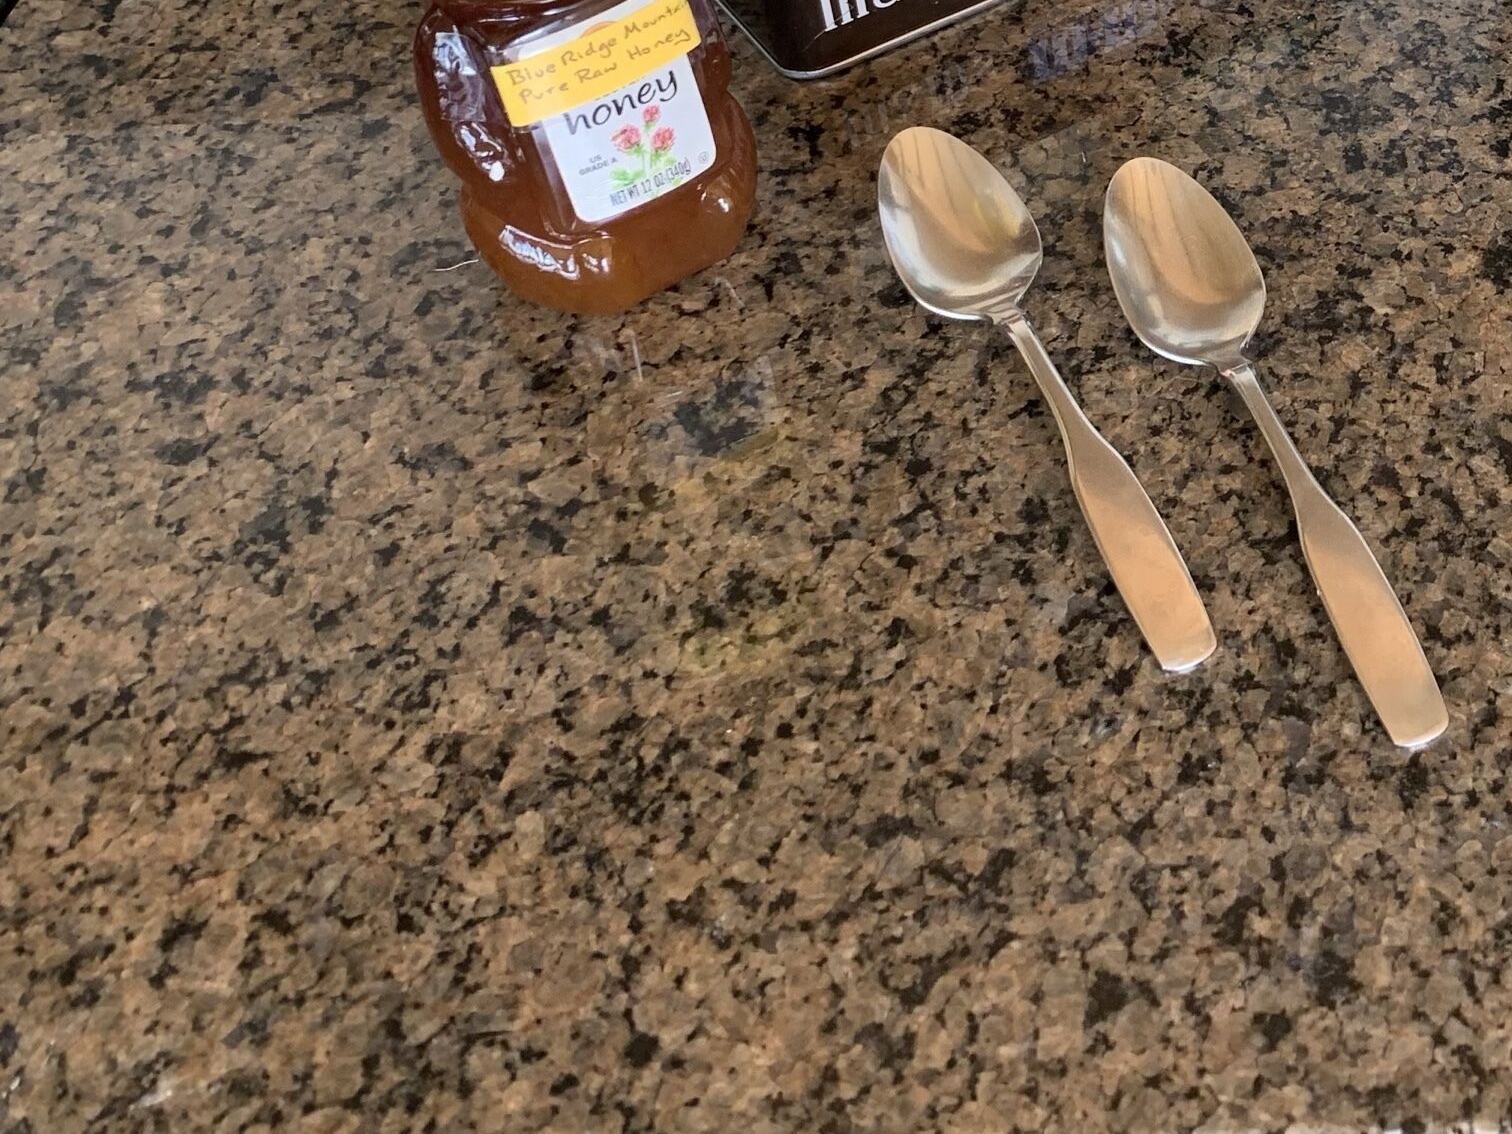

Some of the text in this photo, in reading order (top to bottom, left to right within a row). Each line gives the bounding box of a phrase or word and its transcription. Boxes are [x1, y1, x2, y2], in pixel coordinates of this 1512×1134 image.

[505, 62, 557, 87] Blue
[561, 36, 619, 67] Ridge
[518, 81, 570, 105] Pure
[574, 61, 618, 85] Raw
[562, 69, 679, 136] honey
[609, 189, 628, 207] NET
[640, 178, 653, 195] 12
